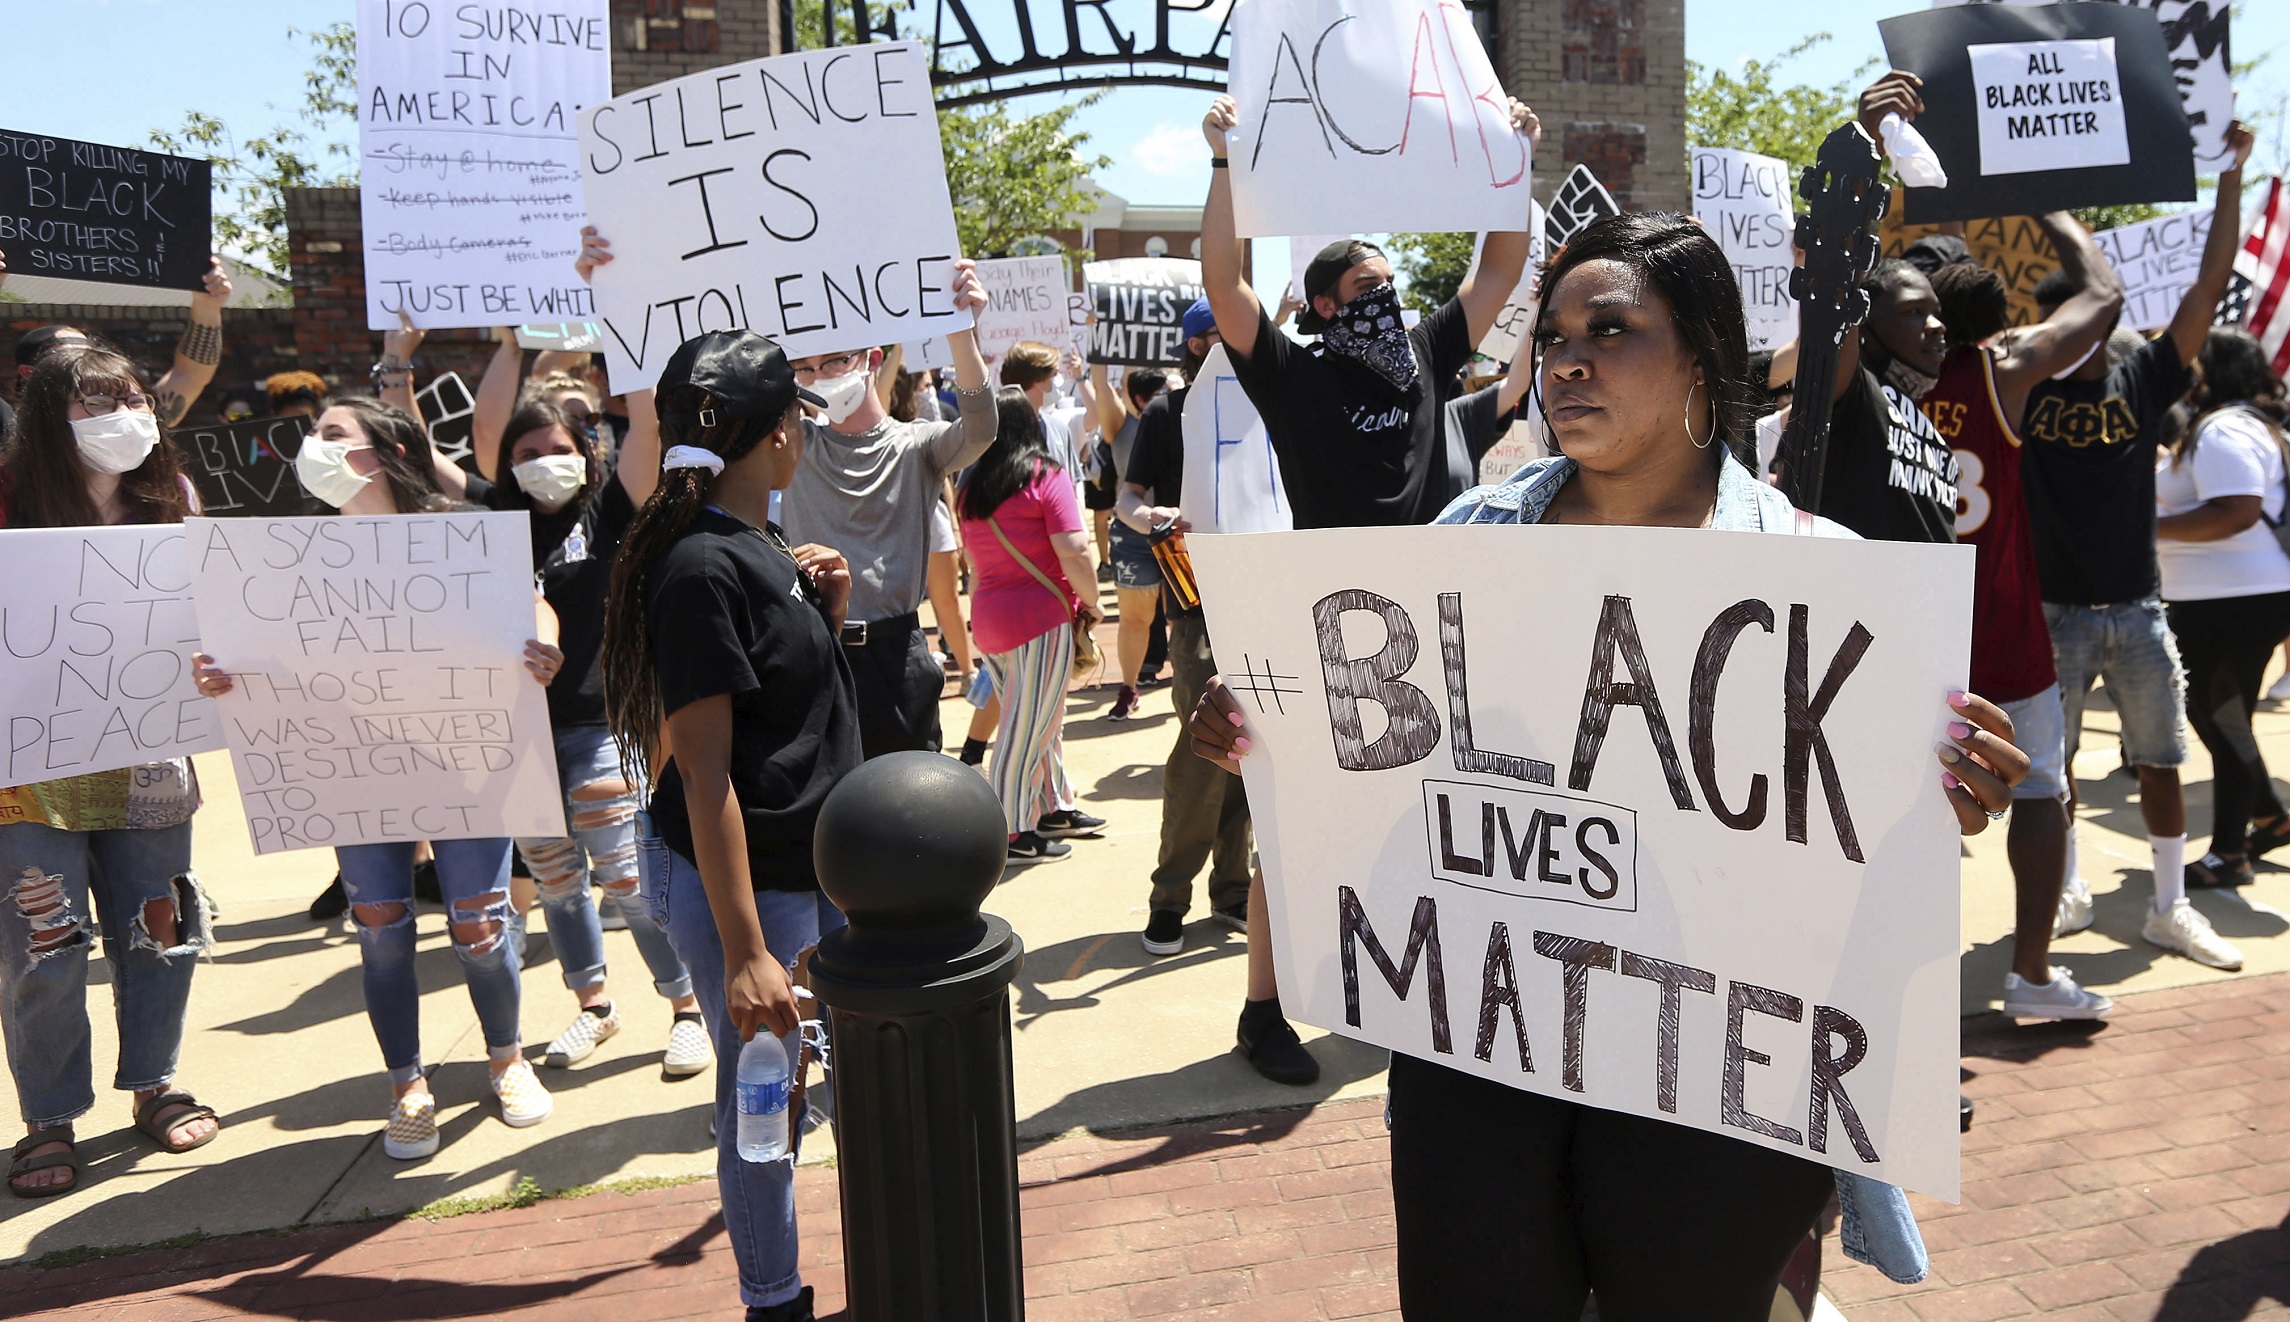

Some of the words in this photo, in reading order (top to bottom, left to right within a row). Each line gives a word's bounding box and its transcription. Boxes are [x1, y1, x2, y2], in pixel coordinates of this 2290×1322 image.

[456, 5, 603, 50] SURVIVE
[444, 50, 511, 81] IN
[2028, 53, 2064, 75] ALL
[591, 49, 917, 174] SILENCE
[1986, 82, 2053, 109] BLACK
[2058, 81, 2111, 104] LIVES
[2008, 111, 2099, 139] MATTER
[72, 142, 148, 176] KILLING
[161, 158, 191, 186] MY
[487, 150, 556, 173] home
[1694, 153, 1790, 210] BLACK
[27, 166, 176, 227] BLACK
[448, 191, 500, 207] hands
[668, 149, 818, 261] IS
[0, 215, 139, 252] BROTHERS
[31, 249, 140, 276] SISTERS
[380, 280, 470, 314] JUST
[481, 285, 521, 313] BE
[603, 255, 955, 371] VIOLENCE
[988, 286, 1052, 312] NAMES
[1090, 284, 1177, 325] LIVES
[1887, 424, 1922, 463] JUST
[79, 535, 192, 598] NO
[201, 523, 243, 572] A
[263, 520, 489, 571] SYSTEM
[242, 571, 491, 622] CANNOT
[297, 616, 445, 656] FAIL
[56, 650, 182, 707] NO
[224, 668, 405, 705] THOSE
[437, 667, 505, 701] IT
[9, 696, 208, 779] PEACE
[233, 717, 335, 747] WAS
[364, 713, 502, 744] NEVER
[243, 745, 515, 787] DESIGNED
[245, 787, 317, 815] TO
[250, 805, 480, 855] PROTECT
[1437, 793, 1620, 900] LIVES
[1337, 885, 1881, 1164] MATTER
